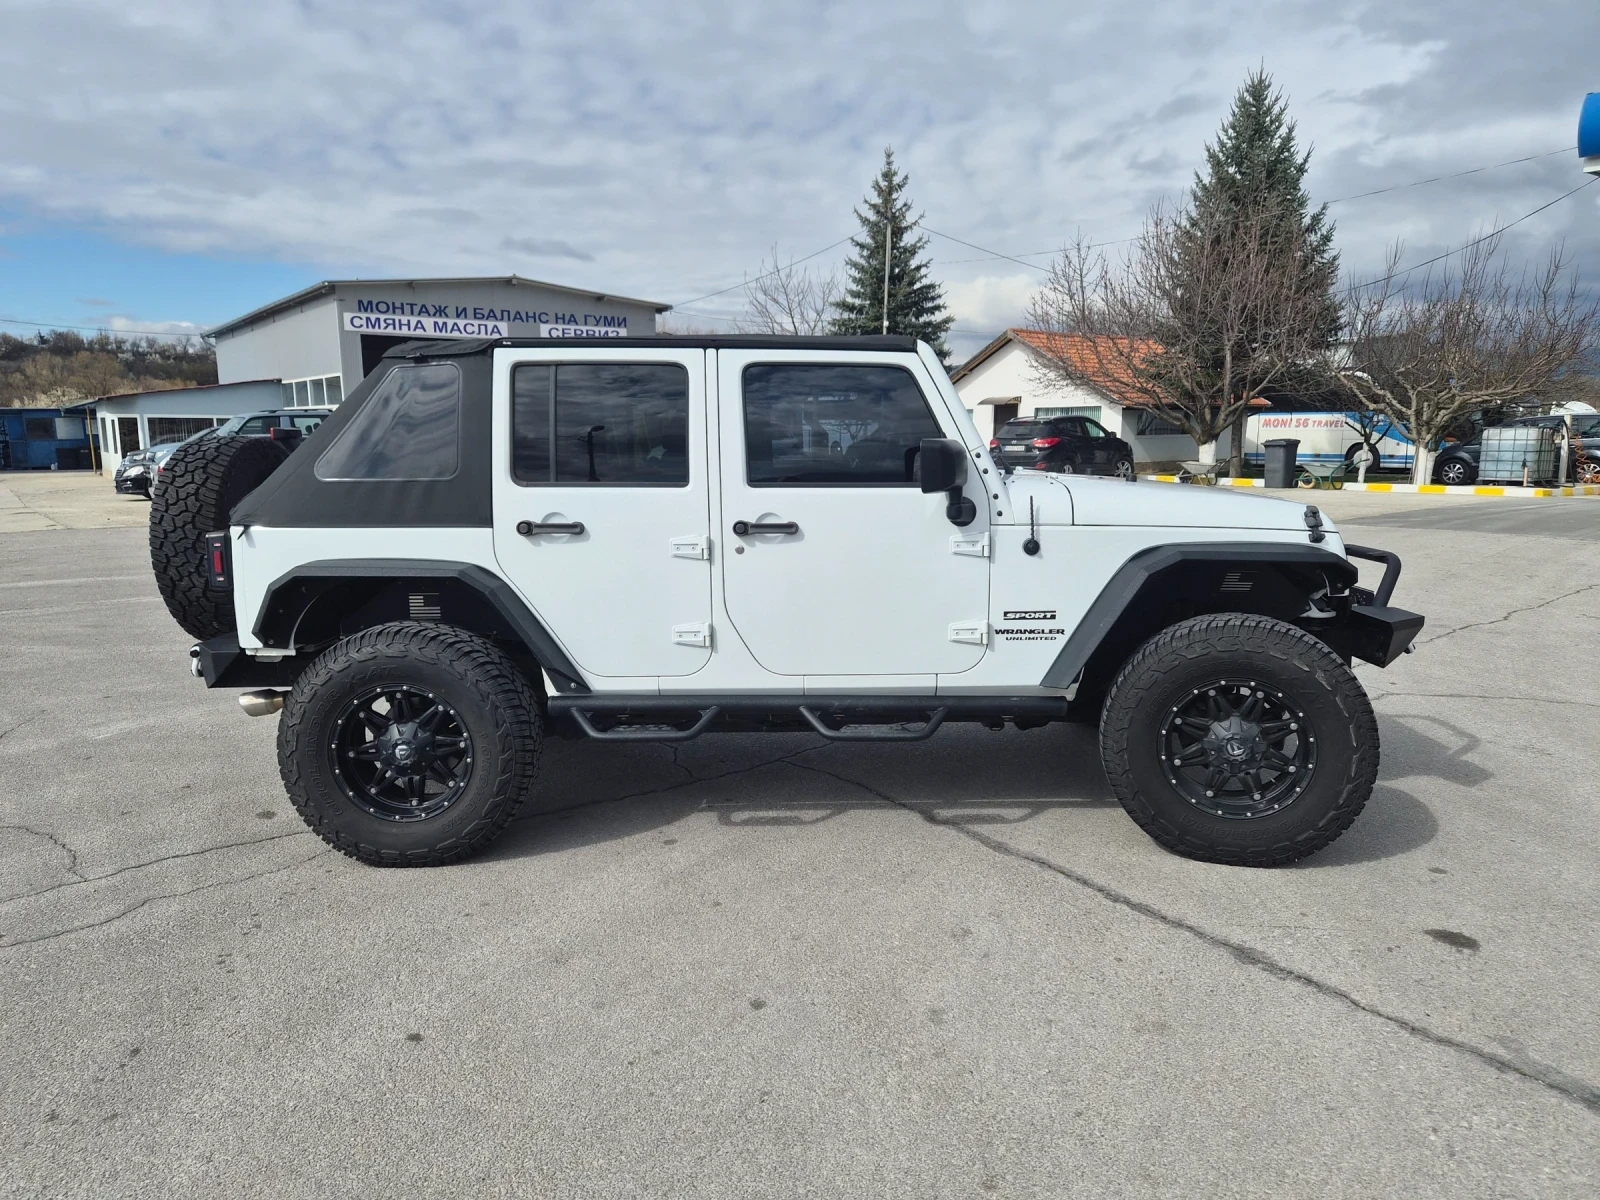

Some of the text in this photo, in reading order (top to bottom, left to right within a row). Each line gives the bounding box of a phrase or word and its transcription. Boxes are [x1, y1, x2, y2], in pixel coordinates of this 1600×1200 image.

[357, 299, 627, 328] МОНТАЖ И БАЛАНС НА ГУМИ
[350, 315, 503, 337] СМЯНА МАСЛА
[1262, 418, 1292, 428] MONI
[1312, 419, 1345, 428] TRAVEL
[1004, 611, 1056, 619] SPORT
